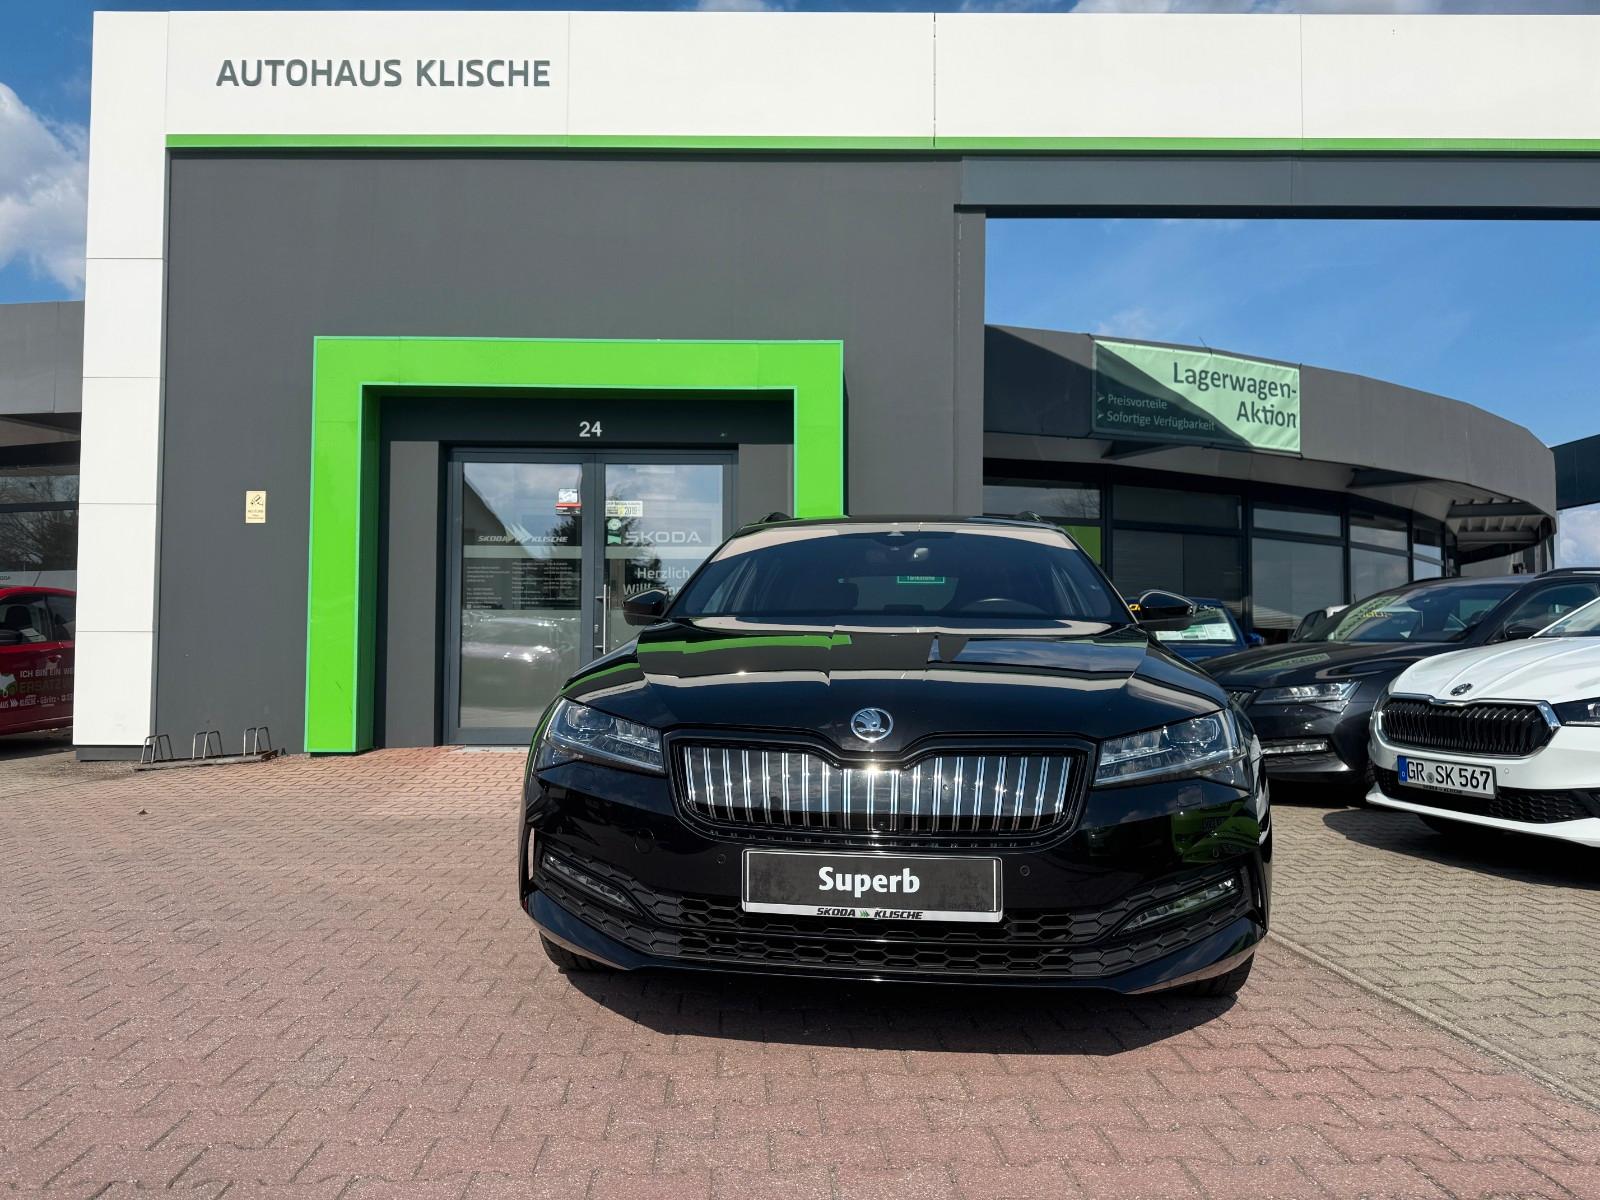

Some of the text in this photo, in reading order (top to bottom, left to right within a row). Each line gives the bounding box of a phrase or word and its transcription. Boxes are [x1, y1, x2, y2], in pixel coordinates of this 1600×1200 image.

[215, 59, 550, 87] AUTOHAUS KLISCHE
[1173, 361, 1297, 400] Lagerwagen-
[1107, 393, 1168, 409] Preisvorteile
[1107, 410, 1216, 431] Sofortige Verfügbarkeit
[1236, 400, 1297, 428] Aktion
[578, 421, 603, 438] 24
[637, 567, 690, 579] Herzlich
[1407, 761, 1426, 782] GR
[1435, 765, 1456, 786] SK
[1459, 768, 1491, 790] 567
[818, 866, 920, 898] Superb
[874, 909, 924, 920] KLISCHE
